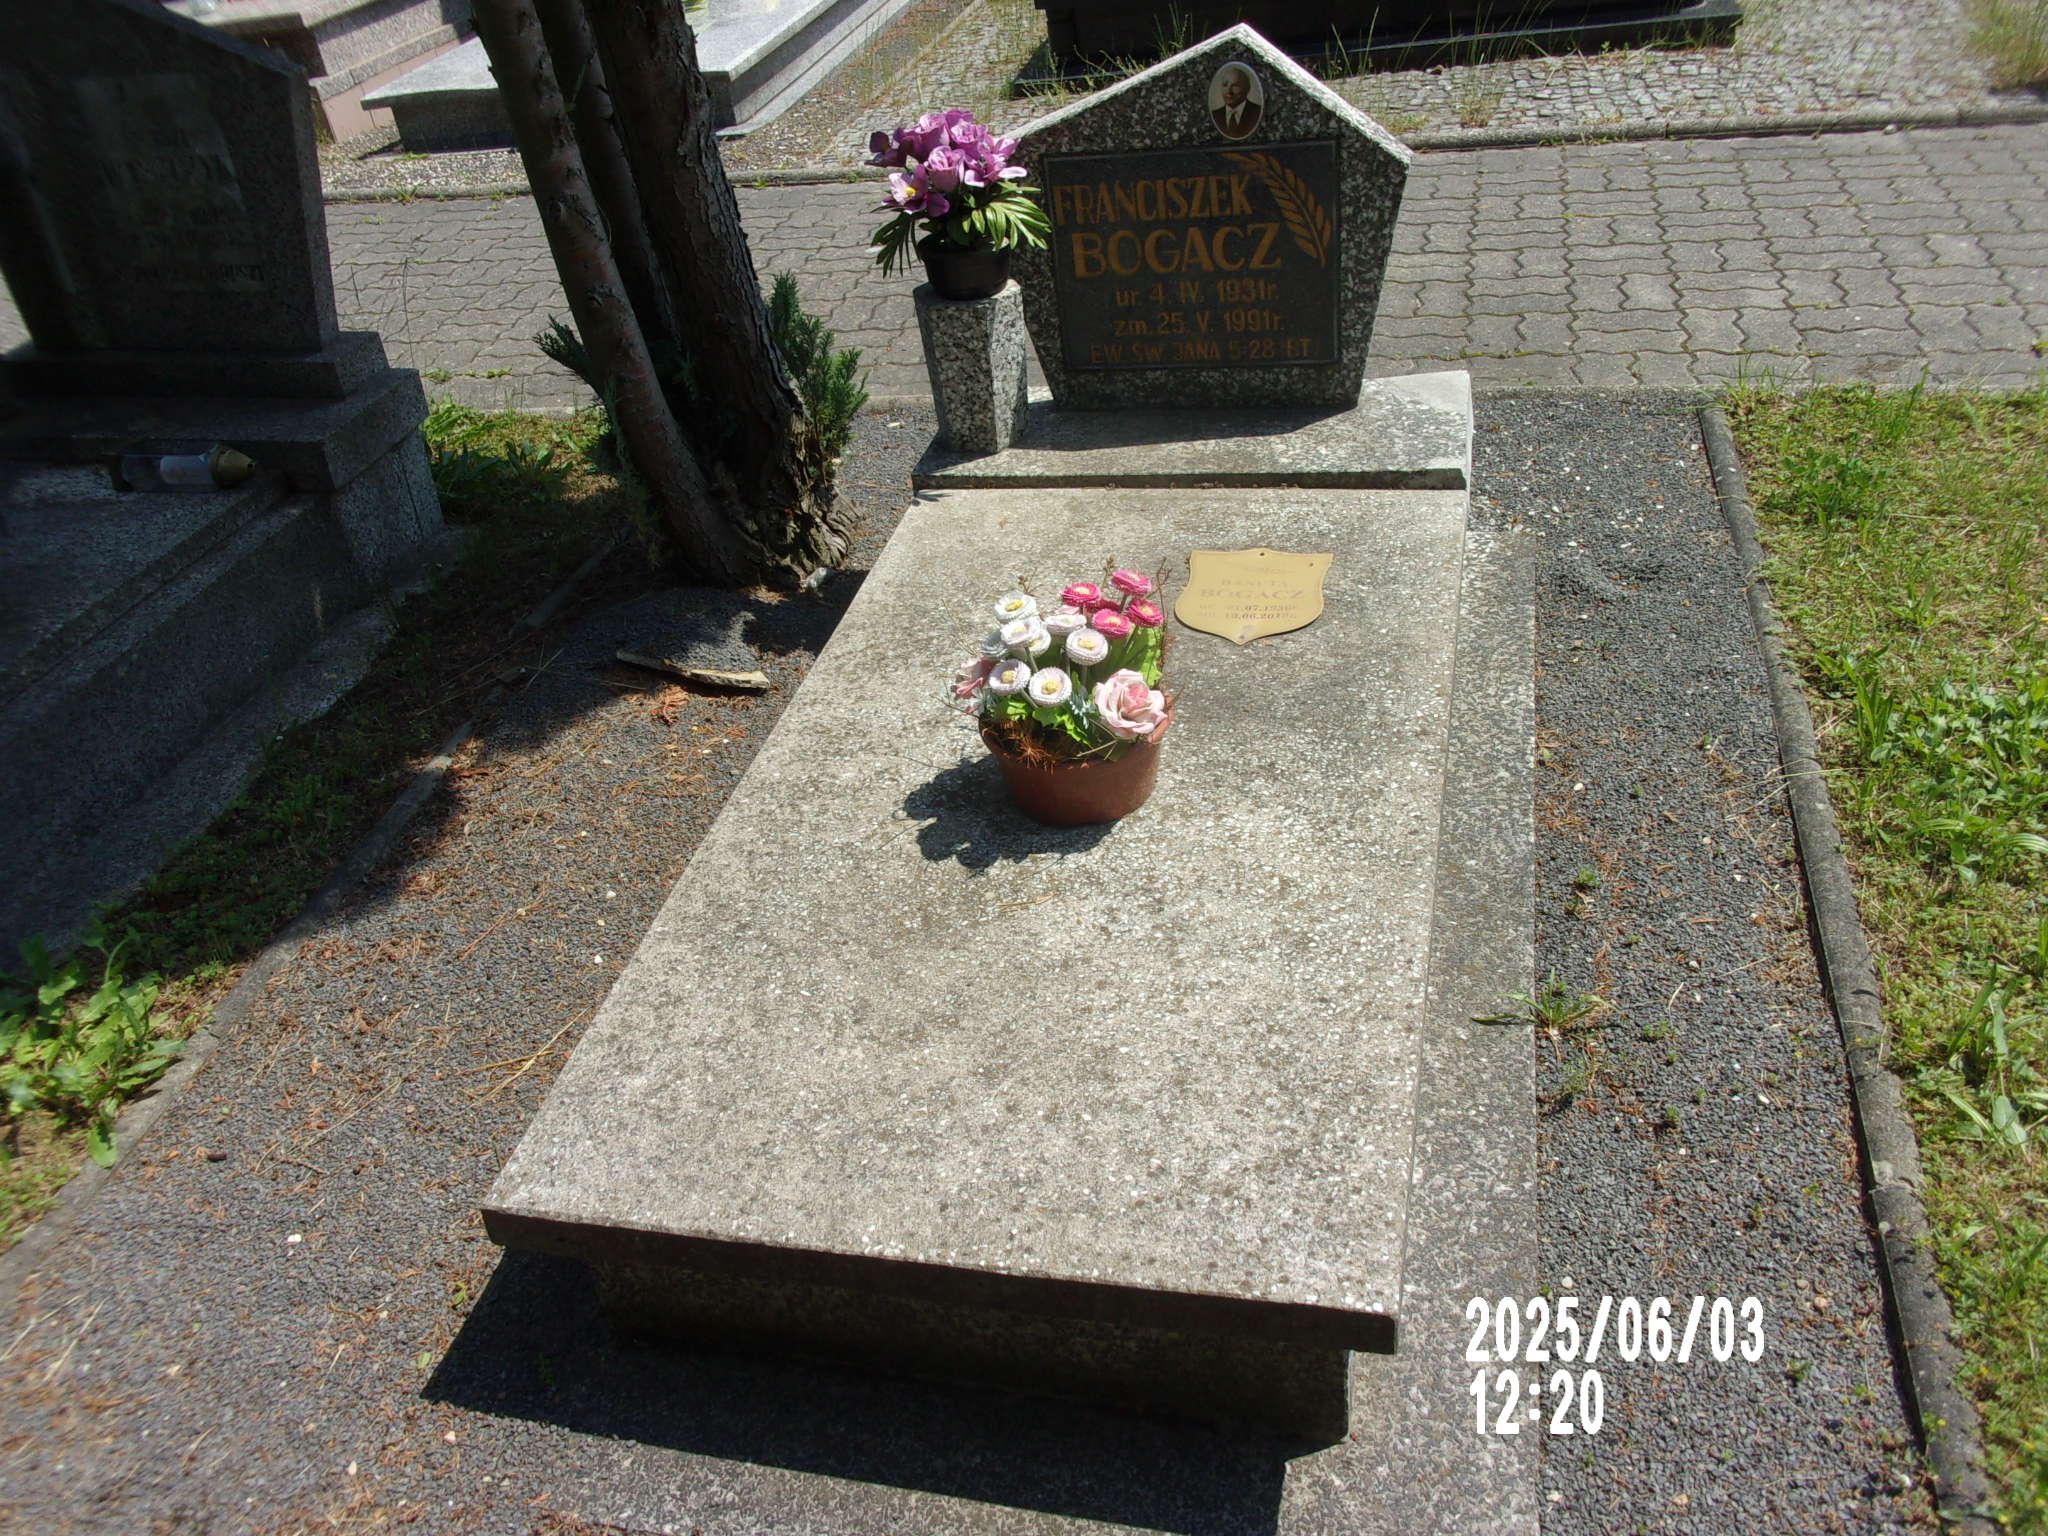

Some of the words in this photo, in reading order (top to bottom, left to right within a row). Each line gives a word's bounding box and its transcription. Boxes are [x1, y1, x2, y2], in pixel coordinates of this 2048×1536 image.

[1052, 174, 1253, 227] FRANCISZEK
[1071, 222, 1282, 280] BOGACZ
[1223, 308, 1285, 333] 1991r.
[1199, 587, 1306, 599] BOGACZ
